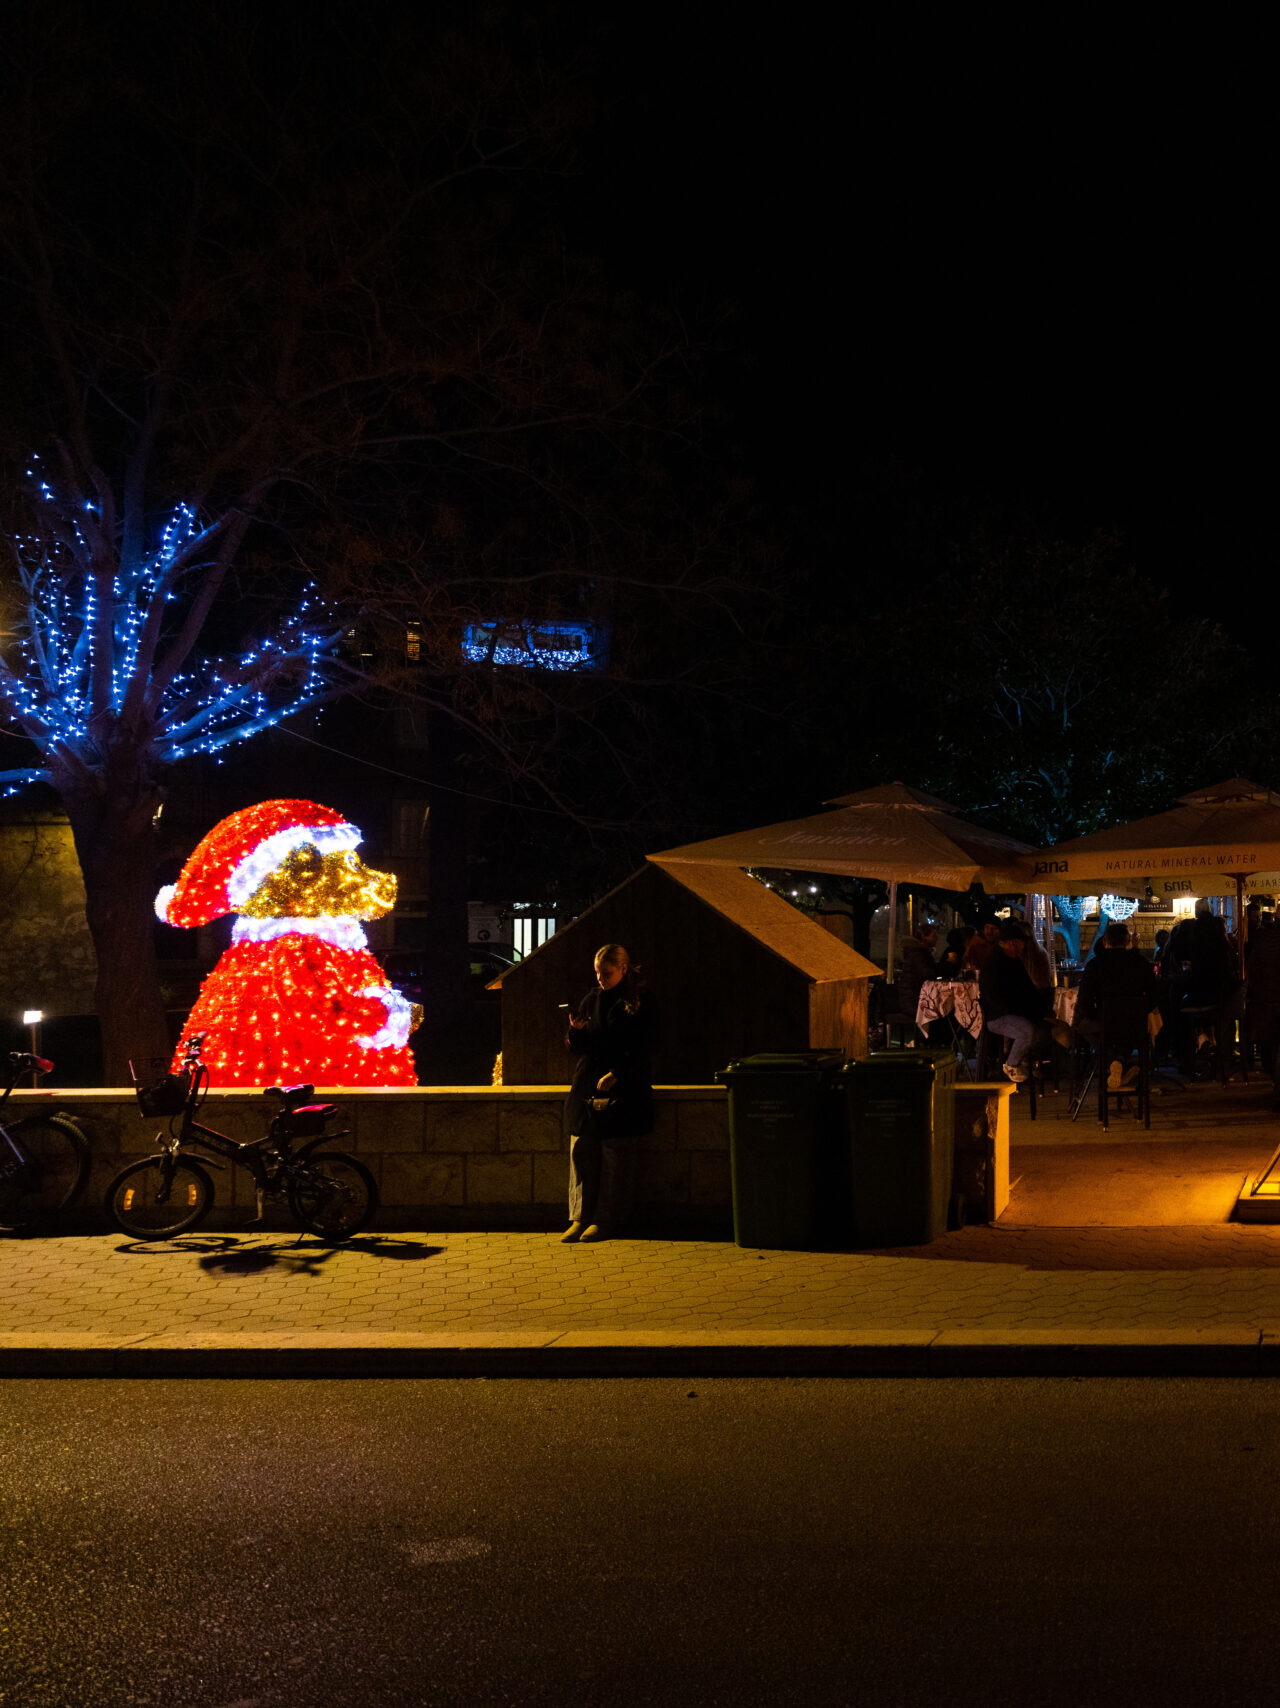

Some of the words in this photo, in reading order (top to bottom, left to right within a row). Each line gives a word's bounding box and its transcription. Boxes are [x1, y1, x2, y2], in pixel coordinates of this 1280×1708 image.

[1105, 859, 1157, 870] NATURAL
[1161, 856, 1212, 868] MINERAL
[1216, 854, 1257, 865] WATER
